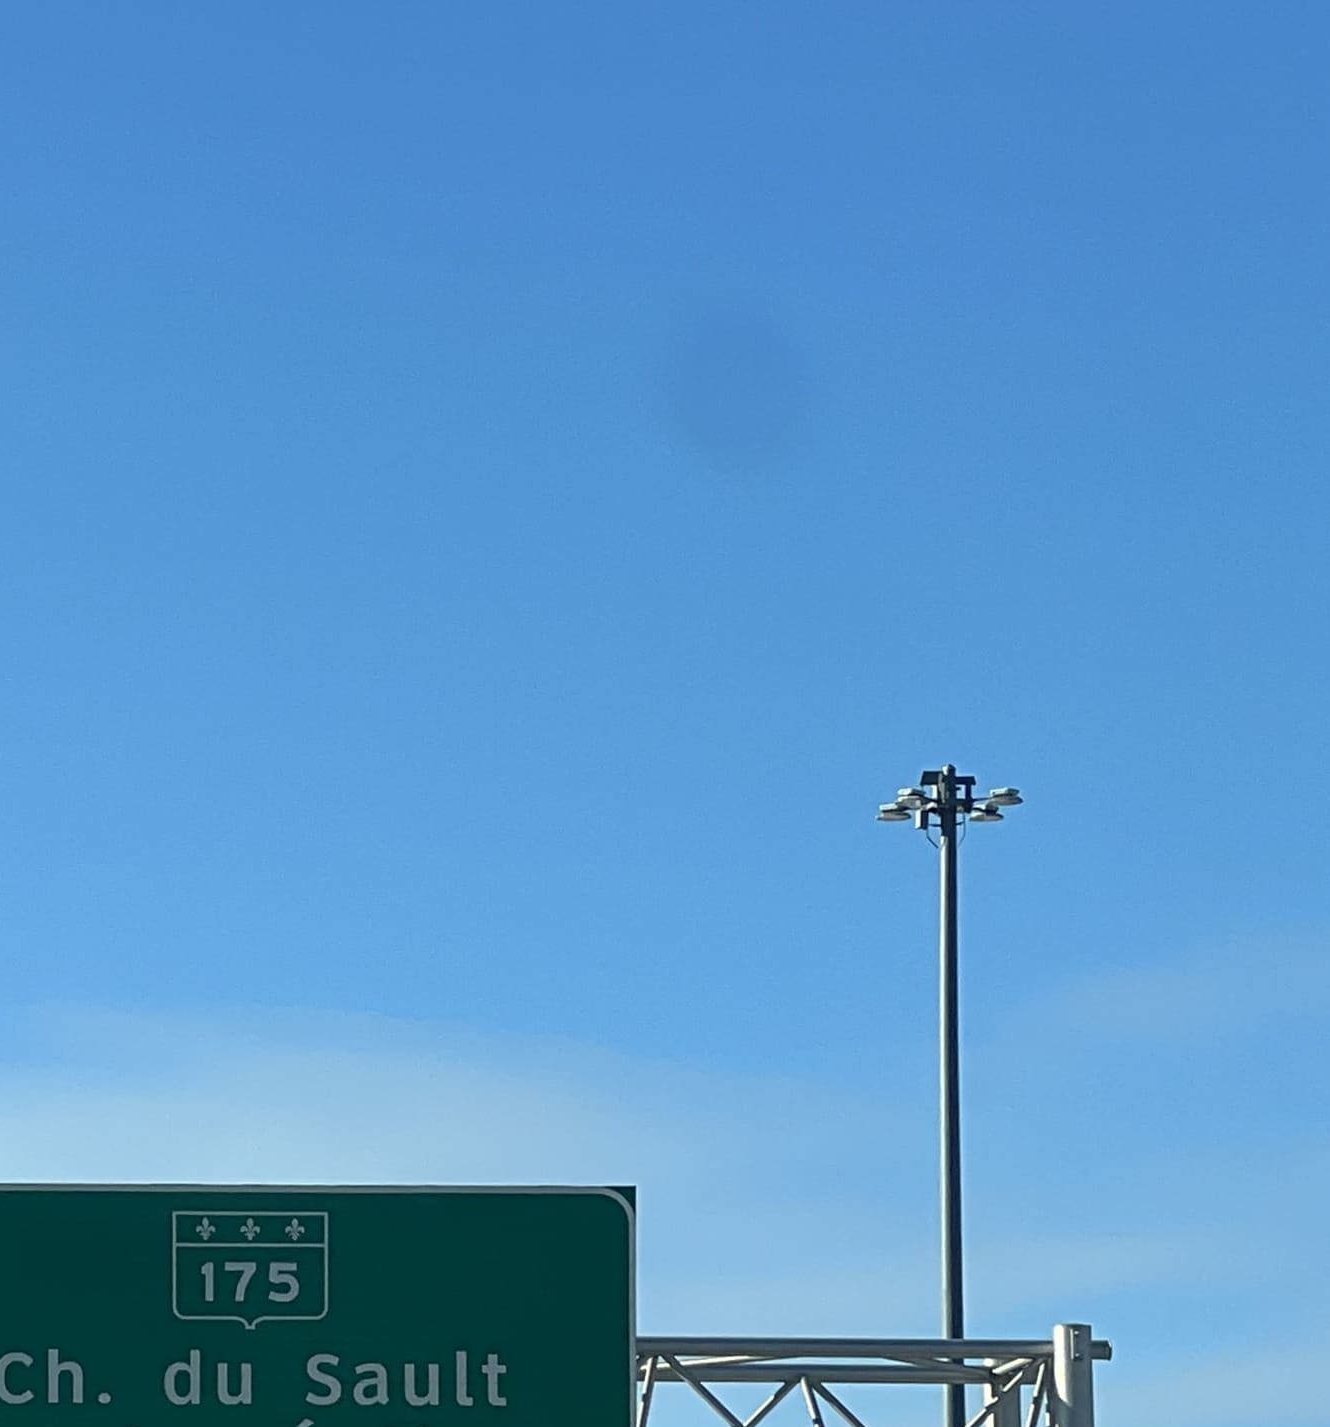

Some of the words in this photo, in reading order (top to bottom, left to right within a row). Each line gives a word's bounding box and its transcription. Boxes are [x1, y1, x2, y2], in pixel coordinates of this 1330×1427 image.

[201, 1262, 300, 1302] 175
[164, 1349, 252, 1405] du
[305, 1351, 507, 1406] Sault
